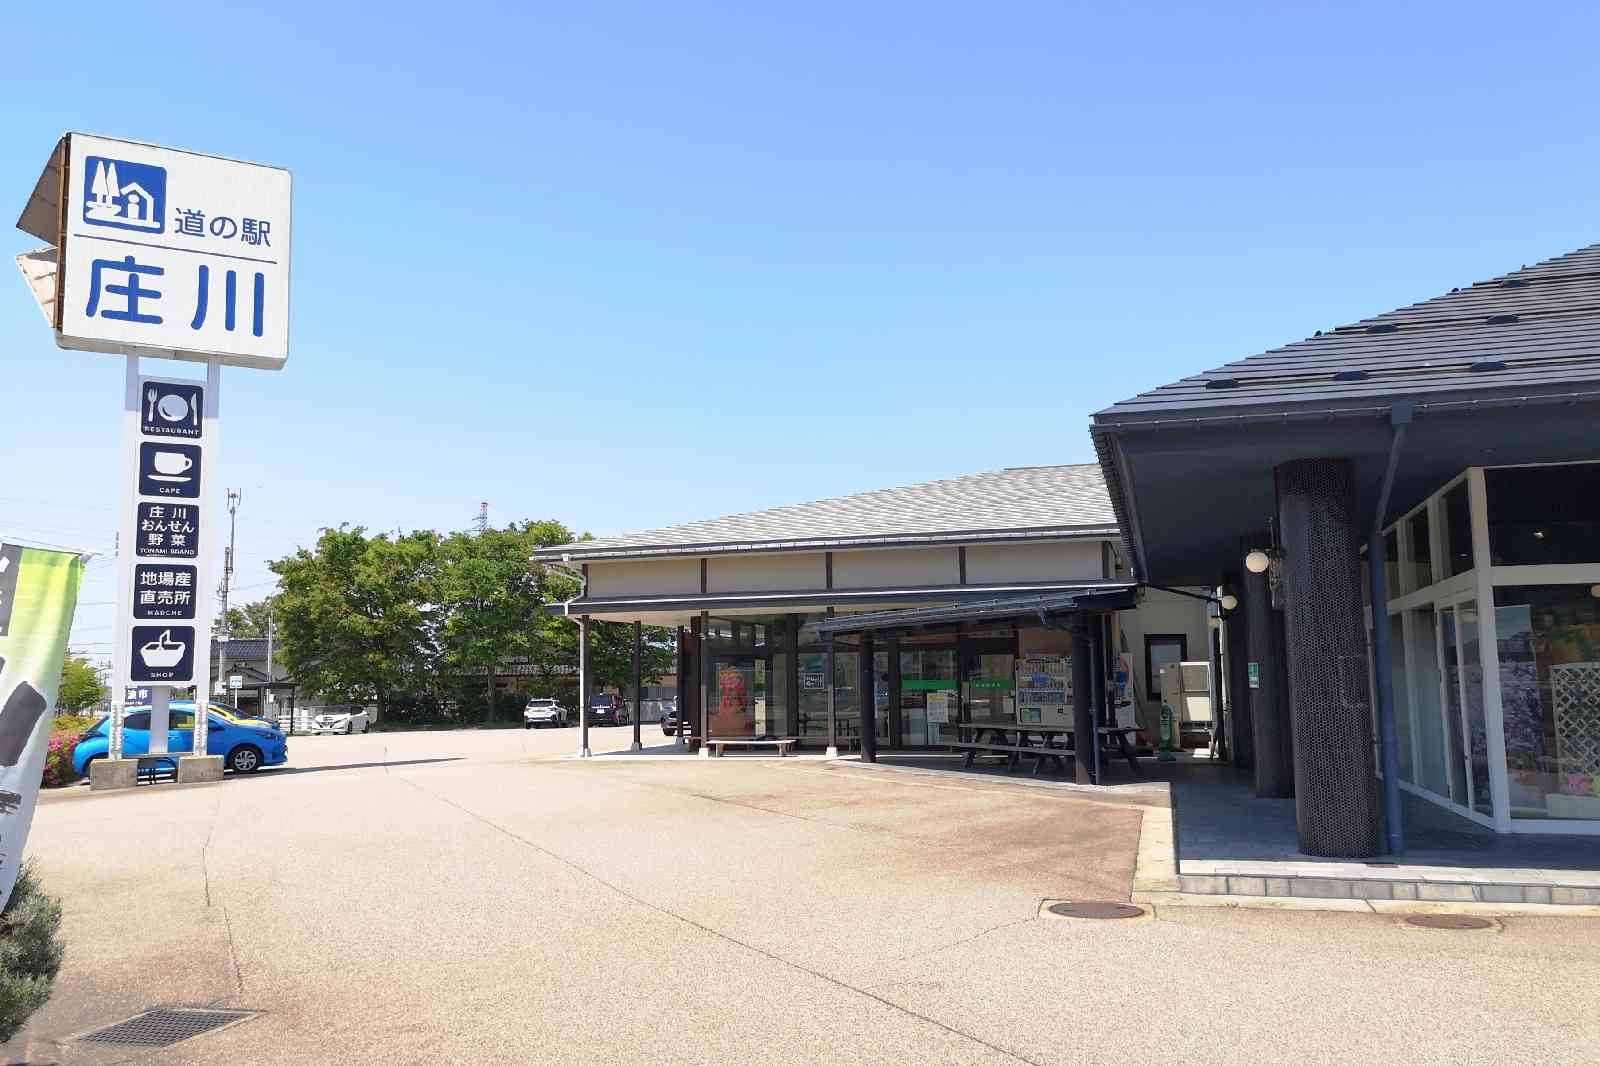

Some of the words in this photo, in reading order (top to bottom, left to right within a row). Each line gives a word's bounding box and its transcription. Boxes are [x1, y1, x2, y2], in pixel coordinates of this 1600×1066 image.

[174, 207, 272, 248] 道の駅
[86, 256, 264, 337] 庄川
[144, 426, 200, 436] RESTAURANT
[149, 505, 187, 519] 庄川
[141, 519, 194, 533] おんせん
[147, 533, 186, 546] 野菜
[140, 571, 192, 587] 地場産
[140, 590, 191, 605] 直売所
